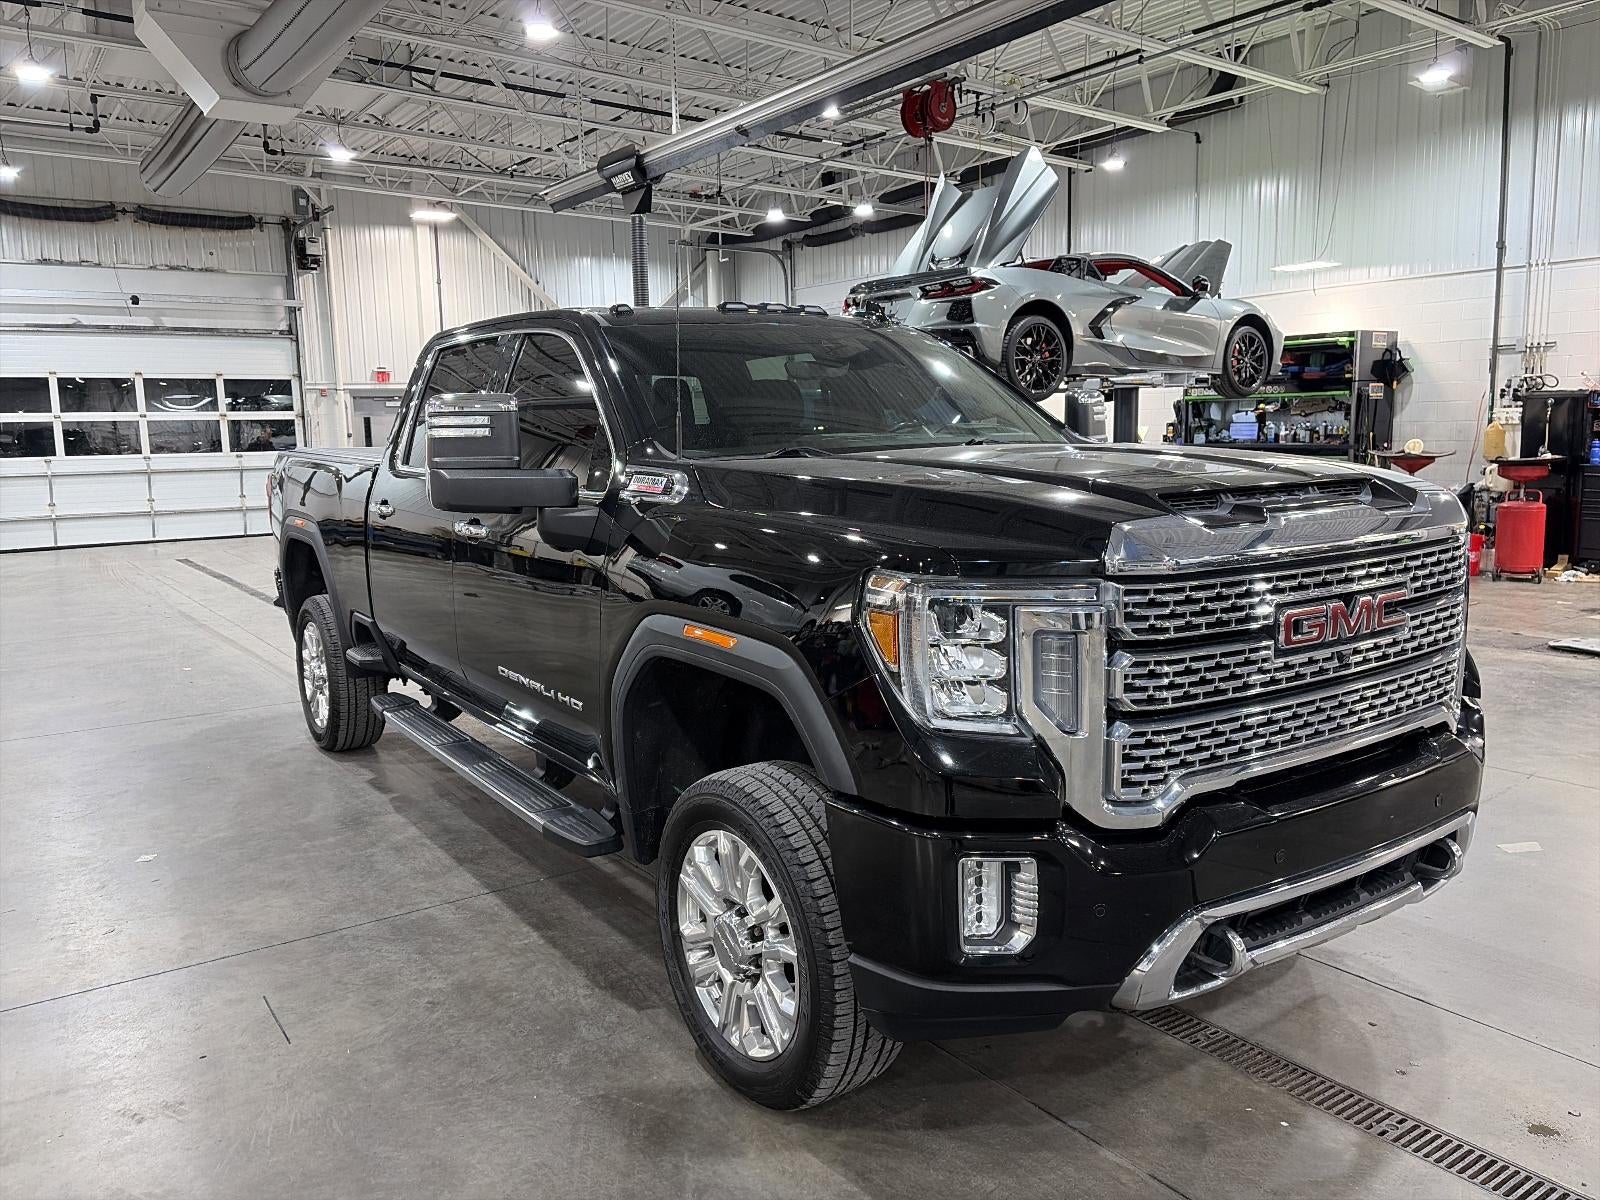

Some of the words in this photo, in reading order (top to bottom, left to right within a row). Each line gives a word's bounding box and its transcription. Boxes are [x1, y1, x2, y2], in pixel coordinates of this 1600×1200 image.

[610, 170, 634, 186] HARVEY
[632, 475, 666, 486] DURAMAX
[1280, 590, 1408, 648] GMC
[498, 665, 555, 699] DENALI
[558, 692, 583, 711] HD
